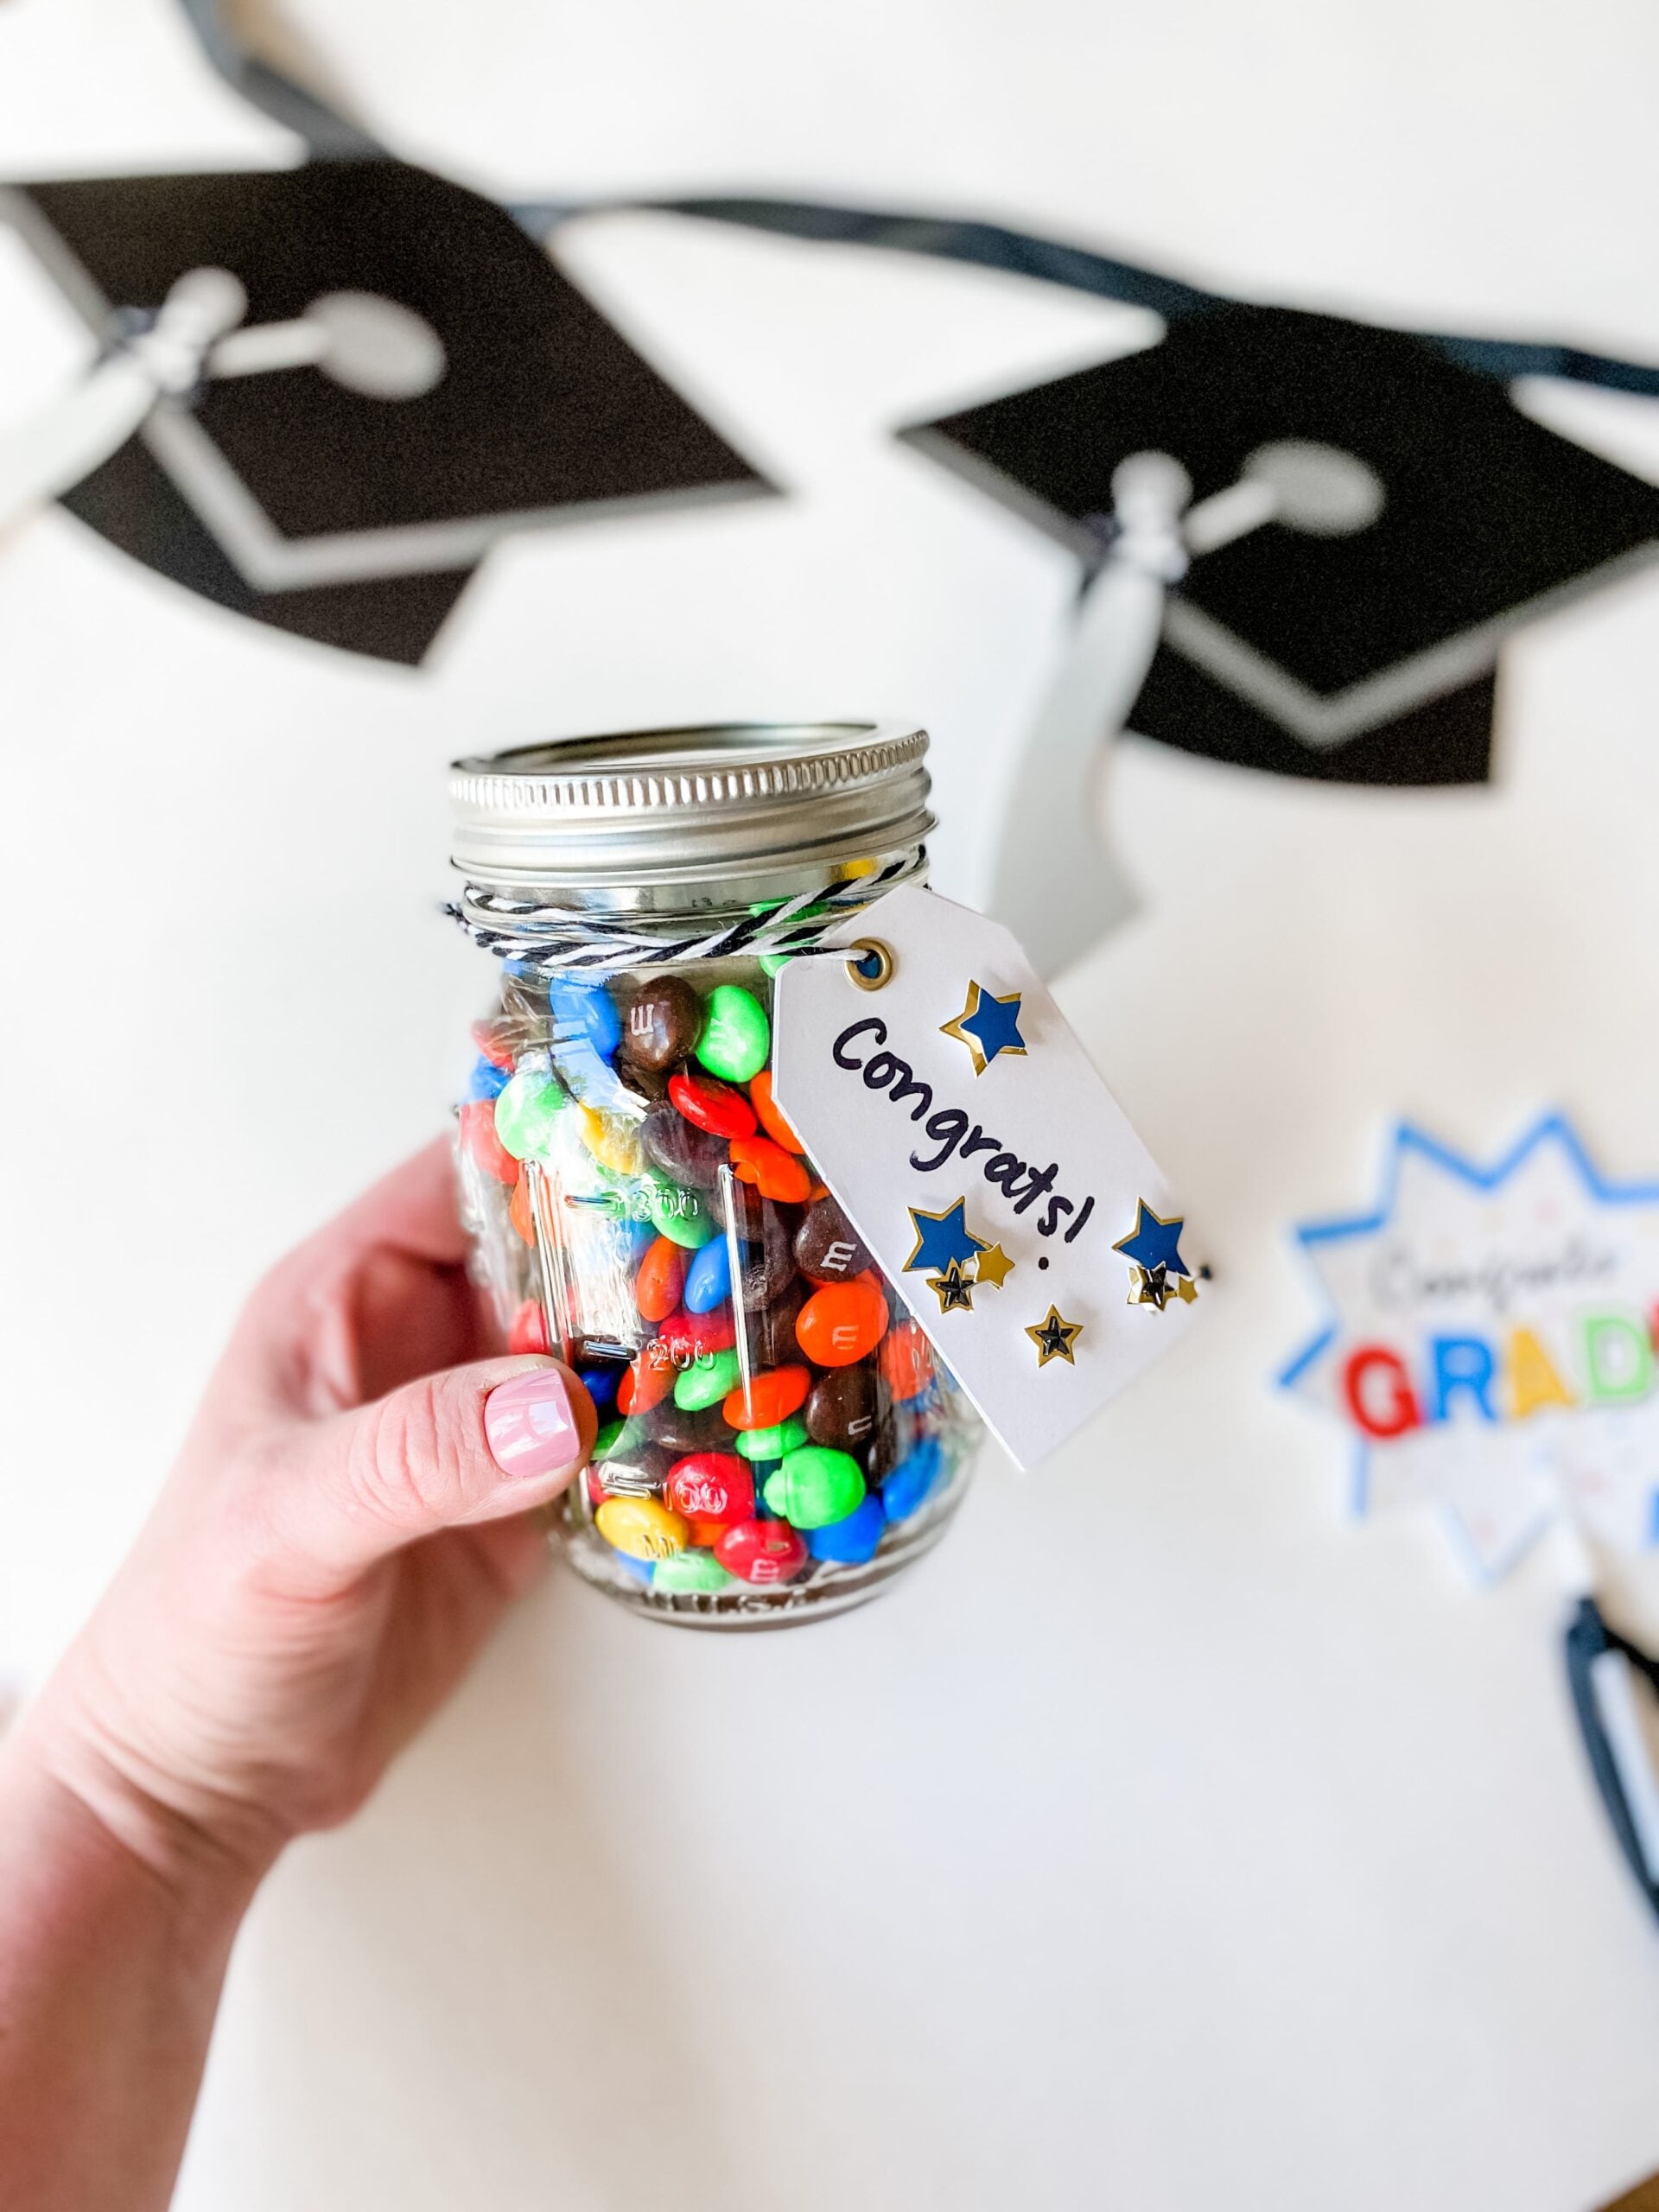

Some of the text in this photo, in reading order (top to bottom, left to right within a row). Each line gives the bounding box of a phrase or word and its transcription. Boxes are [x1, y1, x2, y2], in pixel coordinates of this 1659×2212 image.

[833, 1017, 1095, 1271] Congrats!
[820, 1241, 857, 1272] m
[647, 1335, 716, 1371] 200
[1342, 1298, 1659, 1443] GRAD
